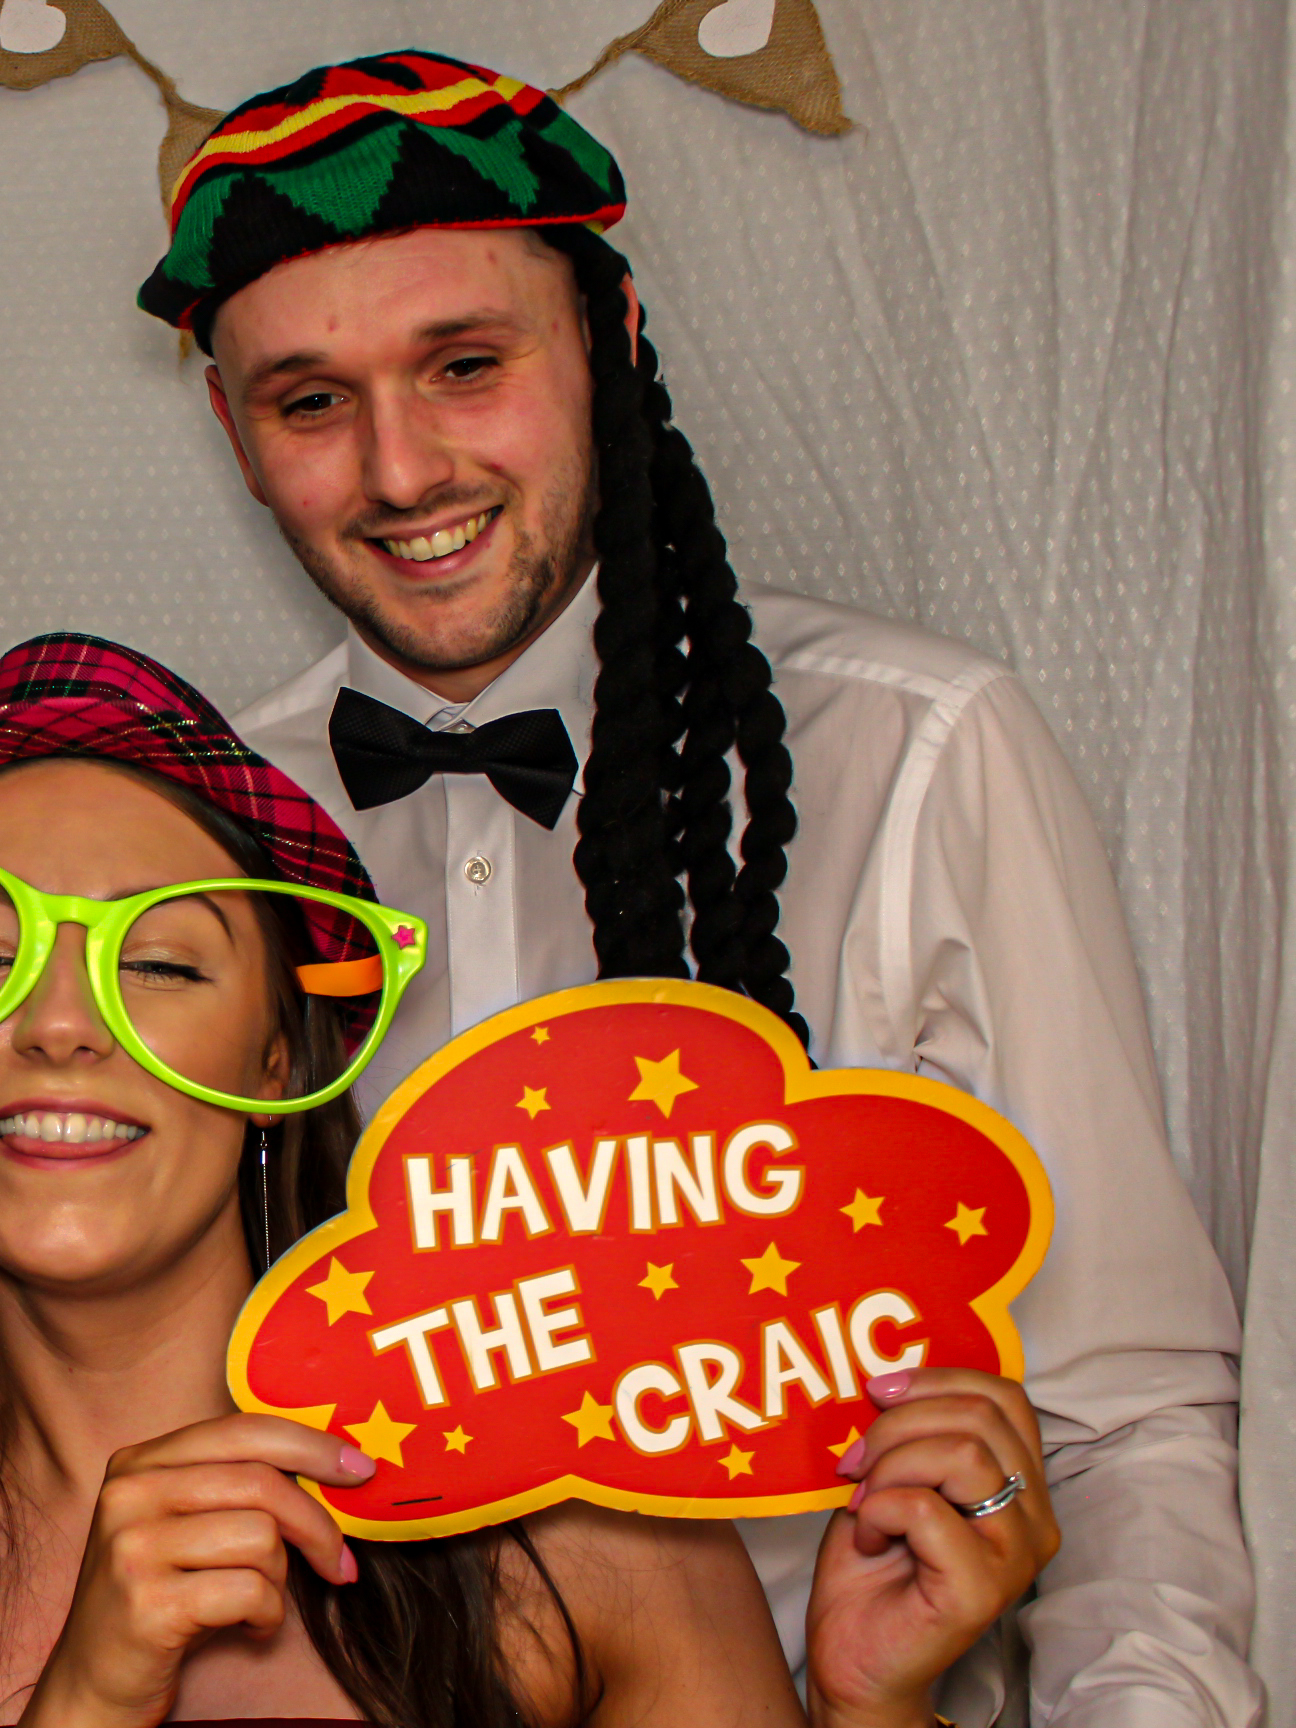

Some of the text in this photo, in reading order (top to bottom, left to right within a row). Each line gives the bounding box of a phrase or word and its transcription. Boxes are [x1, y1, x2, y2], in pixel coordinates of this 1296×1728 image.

[405, 1122, 802, 1250] HAVING
[371, 1269, 592, 1406] THE
[614, 1291, 927, 1454] CRAIC
